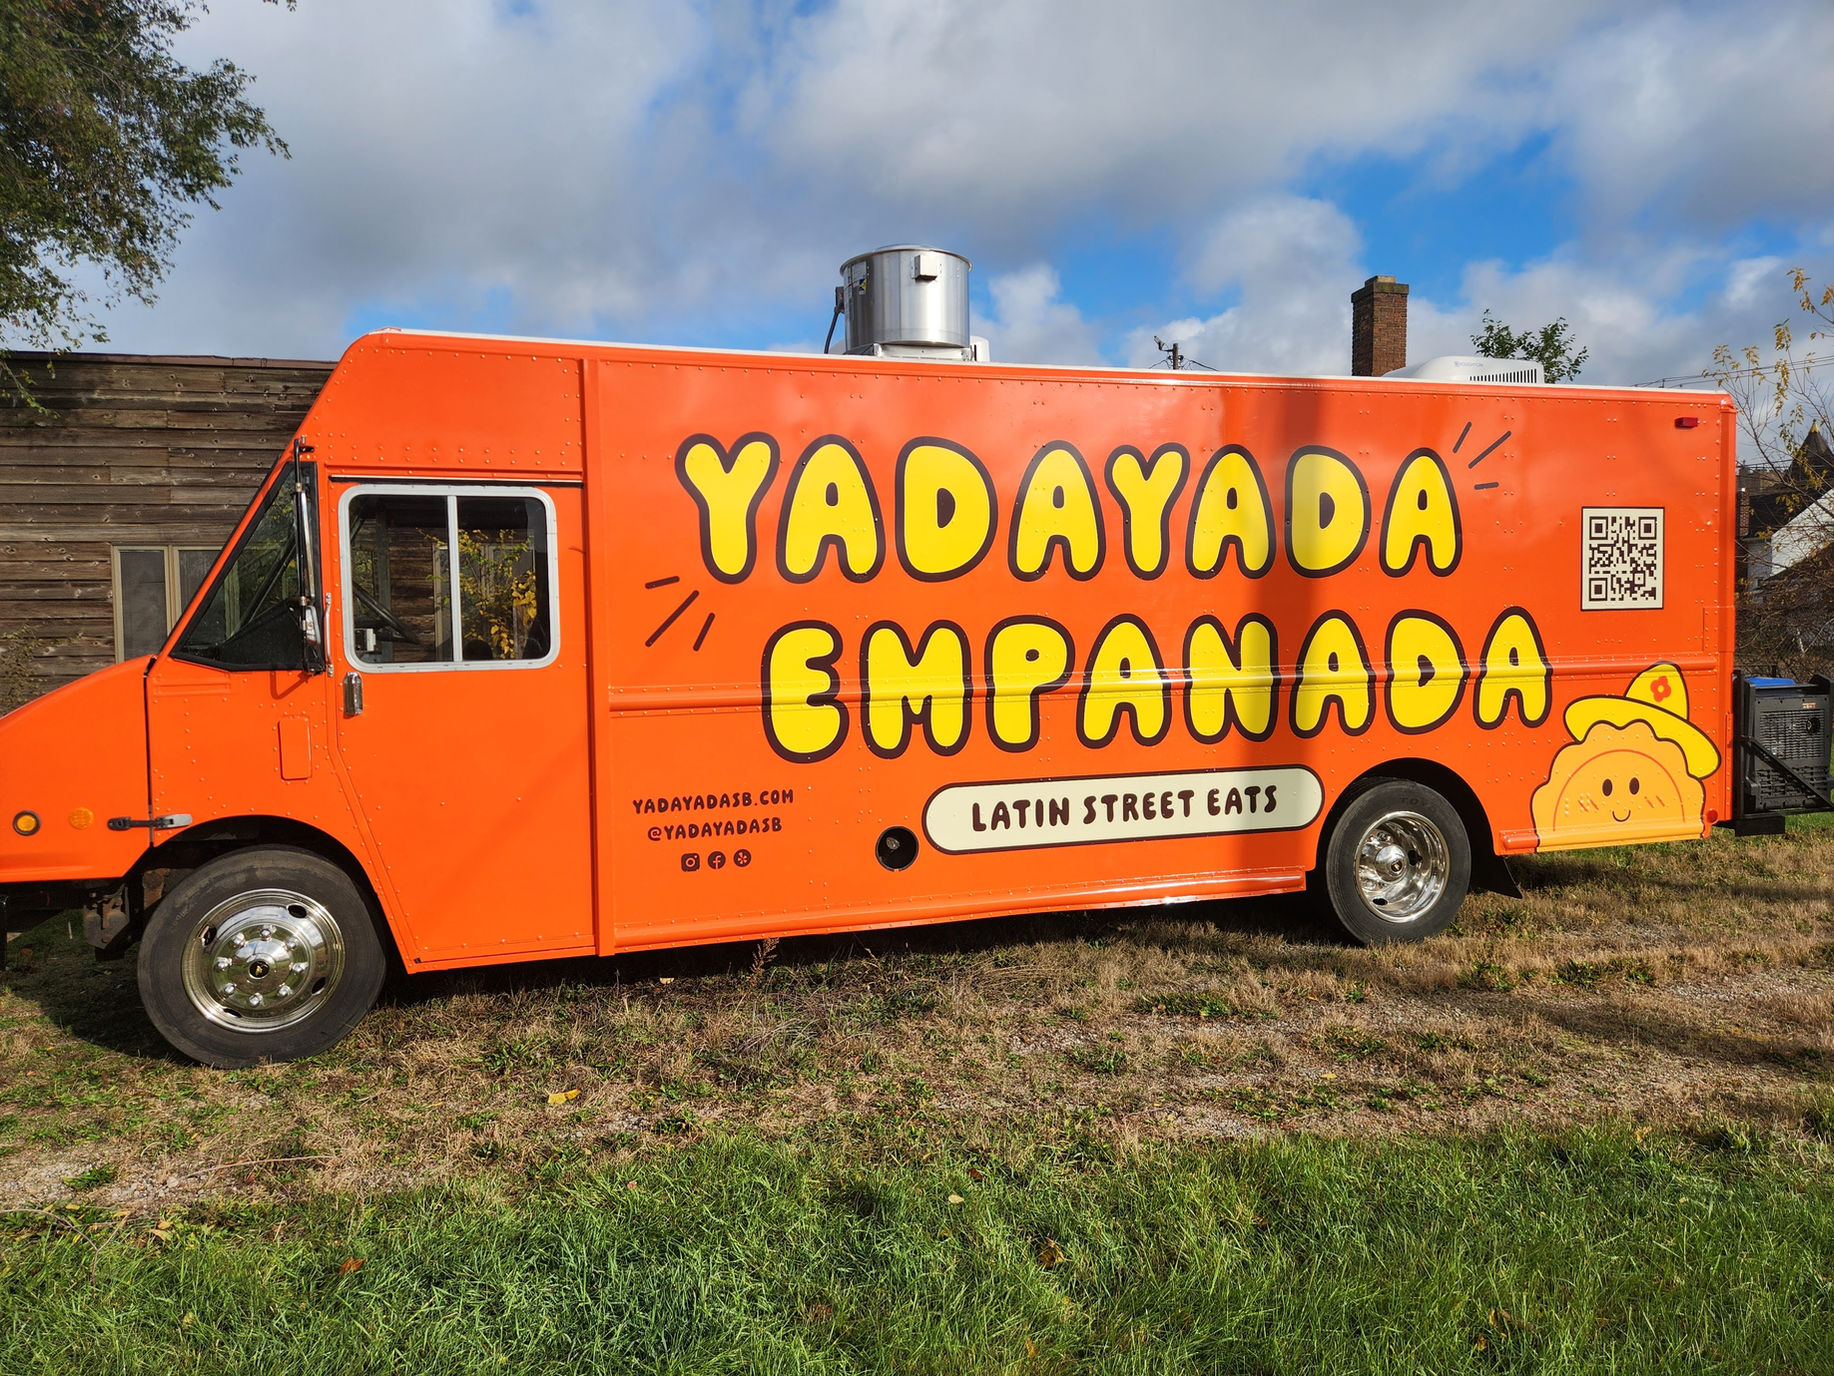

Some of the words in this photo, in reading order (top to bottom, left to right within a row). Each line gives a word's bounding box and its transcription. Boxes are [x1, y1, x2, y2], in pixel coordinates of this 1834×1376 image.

[675, 431, 1463, 584] YADAYADA
[761, 605, 1554, 764] EMPANADA
[633, 789, 794, 814] YADAYADASB.COM
[972, 797, 1070, 832] LATIN
[1083, 789, 1195, 825] STREET
[1208, 784, 1277, 816] EATS
[648, 817, 782, 841] @YADAYADASB
